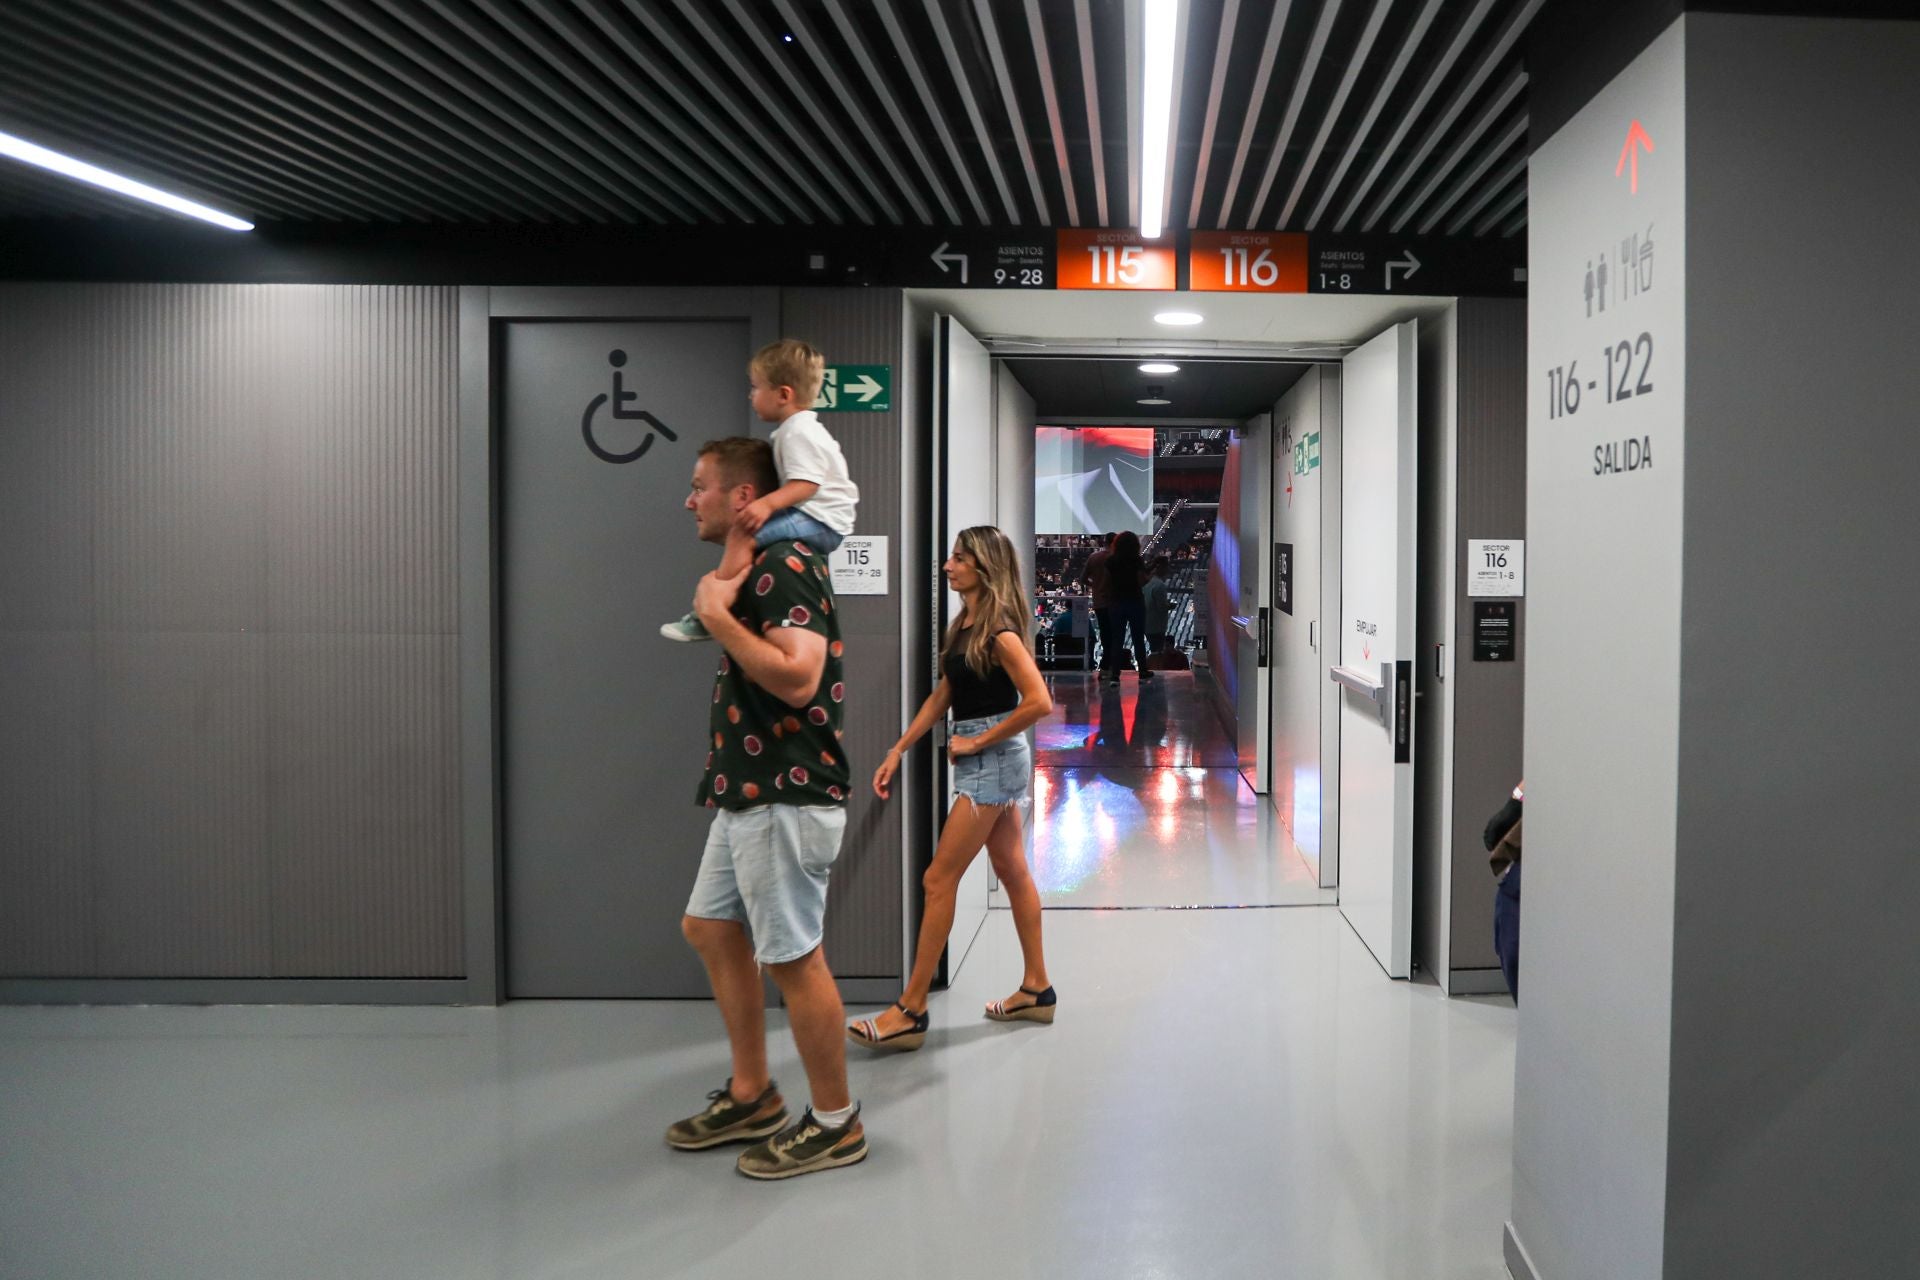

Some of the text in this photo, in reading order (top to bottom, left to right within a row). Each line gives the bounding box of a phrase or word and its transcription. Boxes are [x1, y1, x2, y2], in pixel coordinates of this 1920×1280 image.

[1230, 235, 1269, 245] SECTOR
[998, 246, 1043, 255] ASIENTOS
[1320, 251, 1365, 261] ASIENTOS
[1088, 246, 1146, 285] 115
[1220, 248, 1279, 287] 116
[1593, 435, 1653, 476] SALIDA
[844, 541, 872, 549] SECTOR
[847, 549, 869, 565] 115
[1485, 553, 1507, 568] 116
